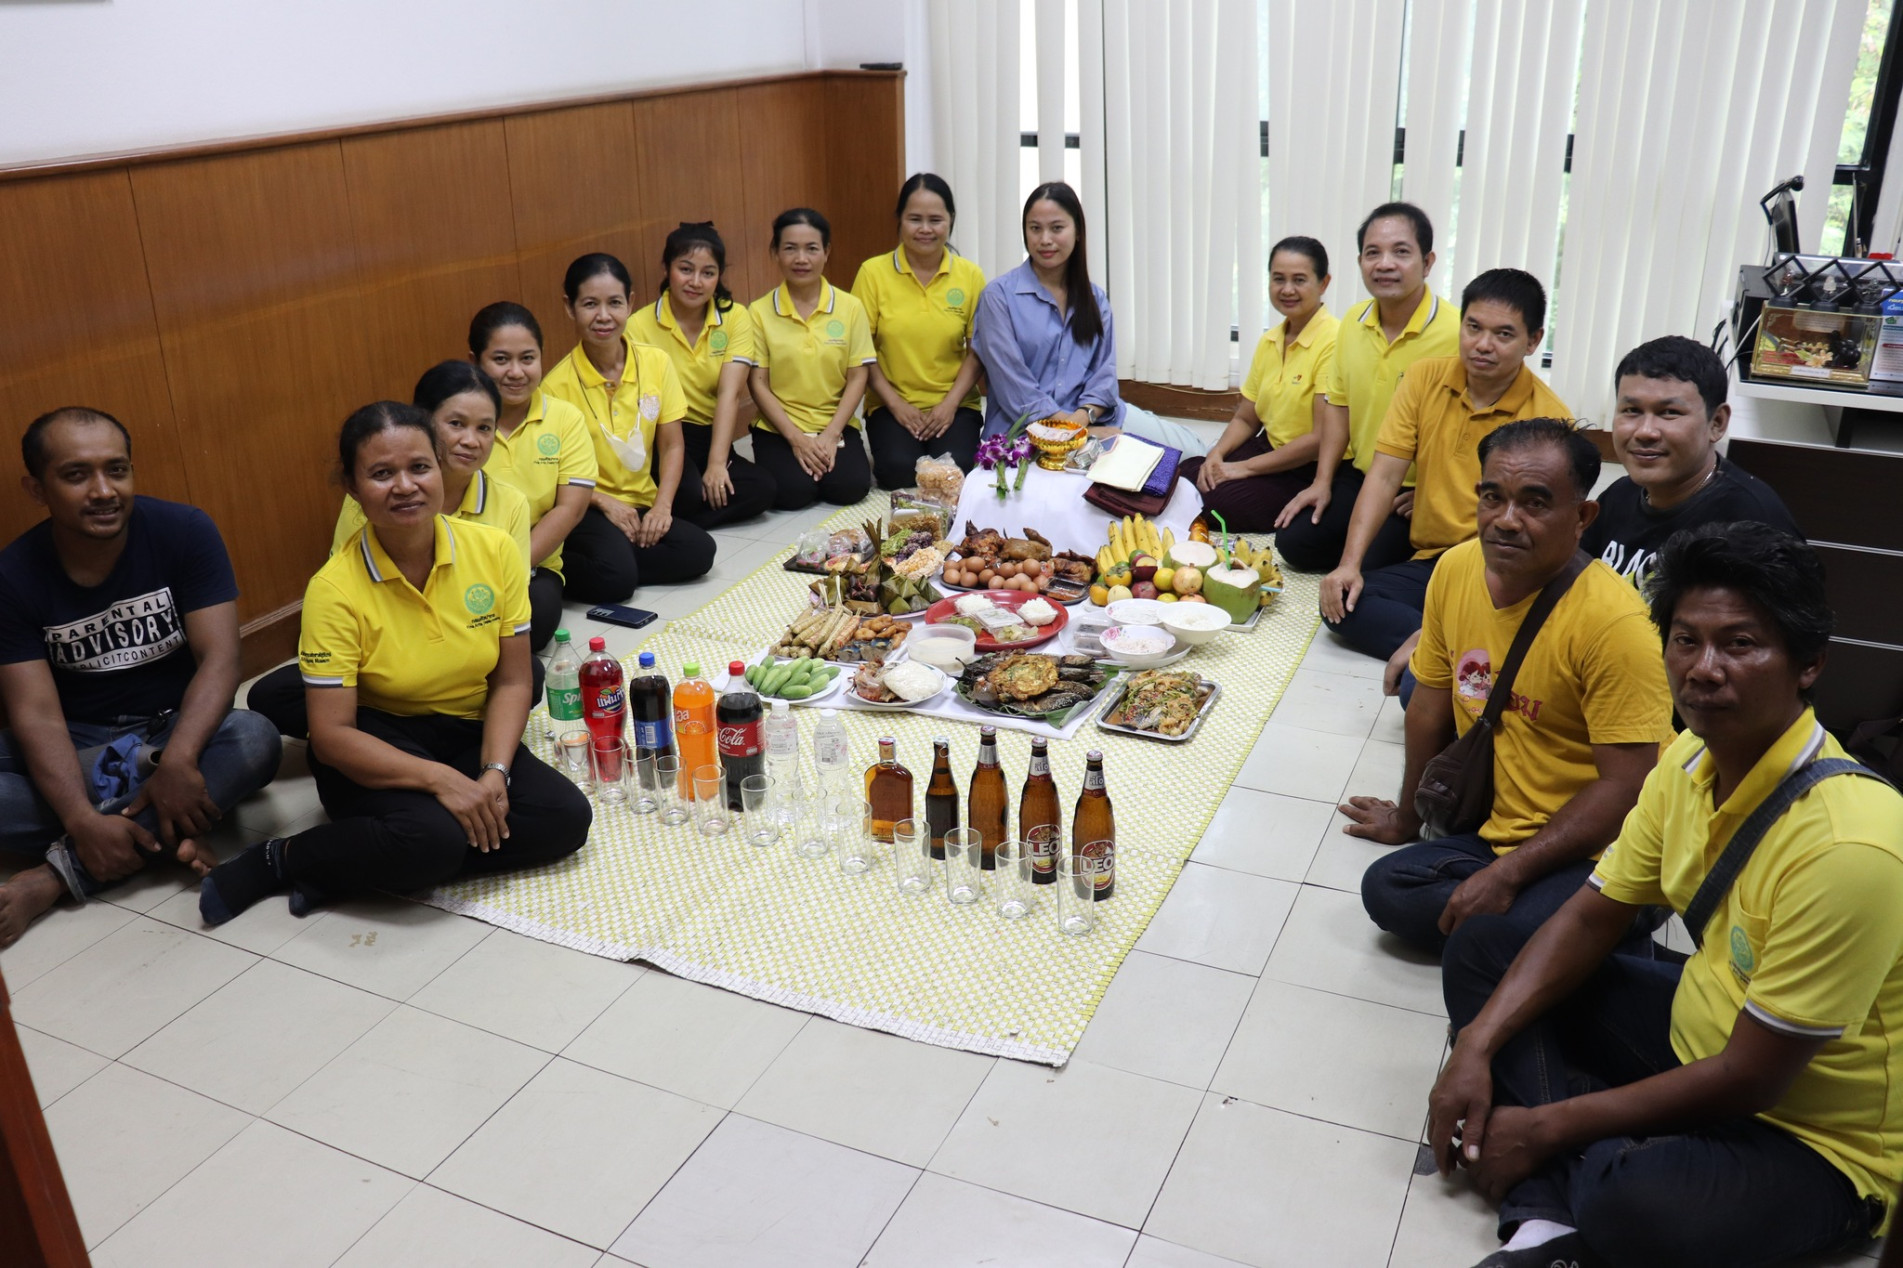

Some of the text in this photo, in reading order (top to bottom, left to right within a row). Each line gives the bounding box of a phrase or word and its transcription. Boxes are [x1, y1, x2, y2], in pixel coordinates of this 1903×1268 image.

[52, 598, 166, 640] PARENTAL
[55, 609, 174, 664] ADVISORY
[719, 727, 747, 746] Cola
[1027, 841, 1060, 856] LEO
[1082, 856, 1114, 873] LEO
